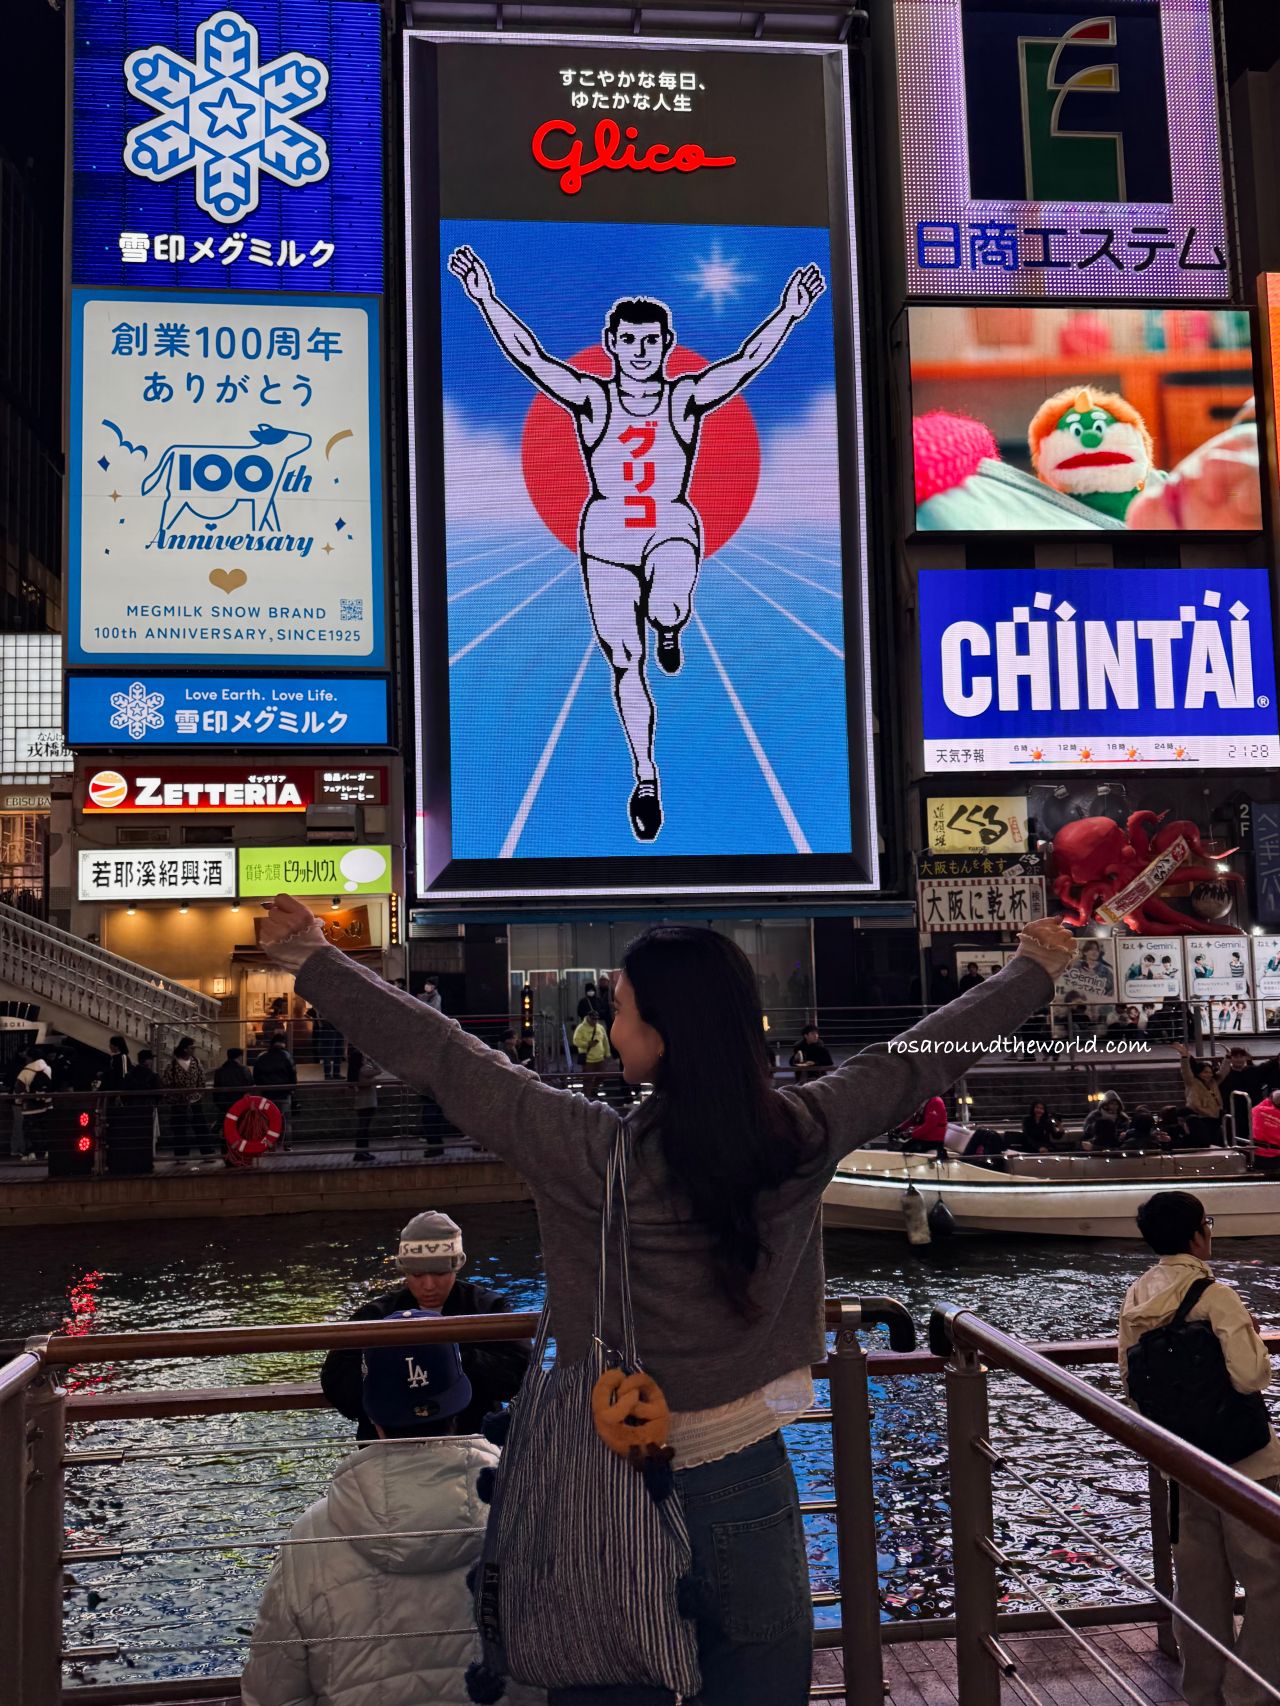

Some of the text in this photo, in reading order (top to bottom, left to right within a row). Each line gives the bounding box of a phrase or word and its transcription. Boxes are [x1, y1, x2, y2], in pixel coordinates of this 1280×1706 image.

[559, 69, 705, 91] すこやかな毎日、
[571, 91, 692, 112] ゆたかな人生
[531, 118, 737, 194] Glico
[119, 232, 335, 268] 雪印メグミルク
[916, 220, 1227, 273] 日商エステム
[111, 321, 343, 361] 創業100周年
[143, 371, 313, 407] ありがとう
[618, 421, 657, 529] グリコ
[145, 528, 313, 557] Anniversary
[127, 605, 326, 619] MEGMILK SNOW BRAND
[94, 627, 137, 639] 100th
[185, 688, 338, 702] Love Earth. Love Life.
[174, 706, 348, 735] 雪印メグミルク
[936, 749, 984, 763] 天気予報
[1107, 743, 1126, 751] 18時
[1154, 742, 1174, 750] 24時
[134, 777, 303, 806] ZETTERIA
[248, 775, 287, 784] ゼッテリア
[340, 793, 375, 801] コーヒー
[947, 804, 1008, 845] くくる
[284, 860, 338, 882] ピタットハウス
[926, 886, 1028, 922] 大阪に乾杯
[405, 1357, 429, 1388] LA
